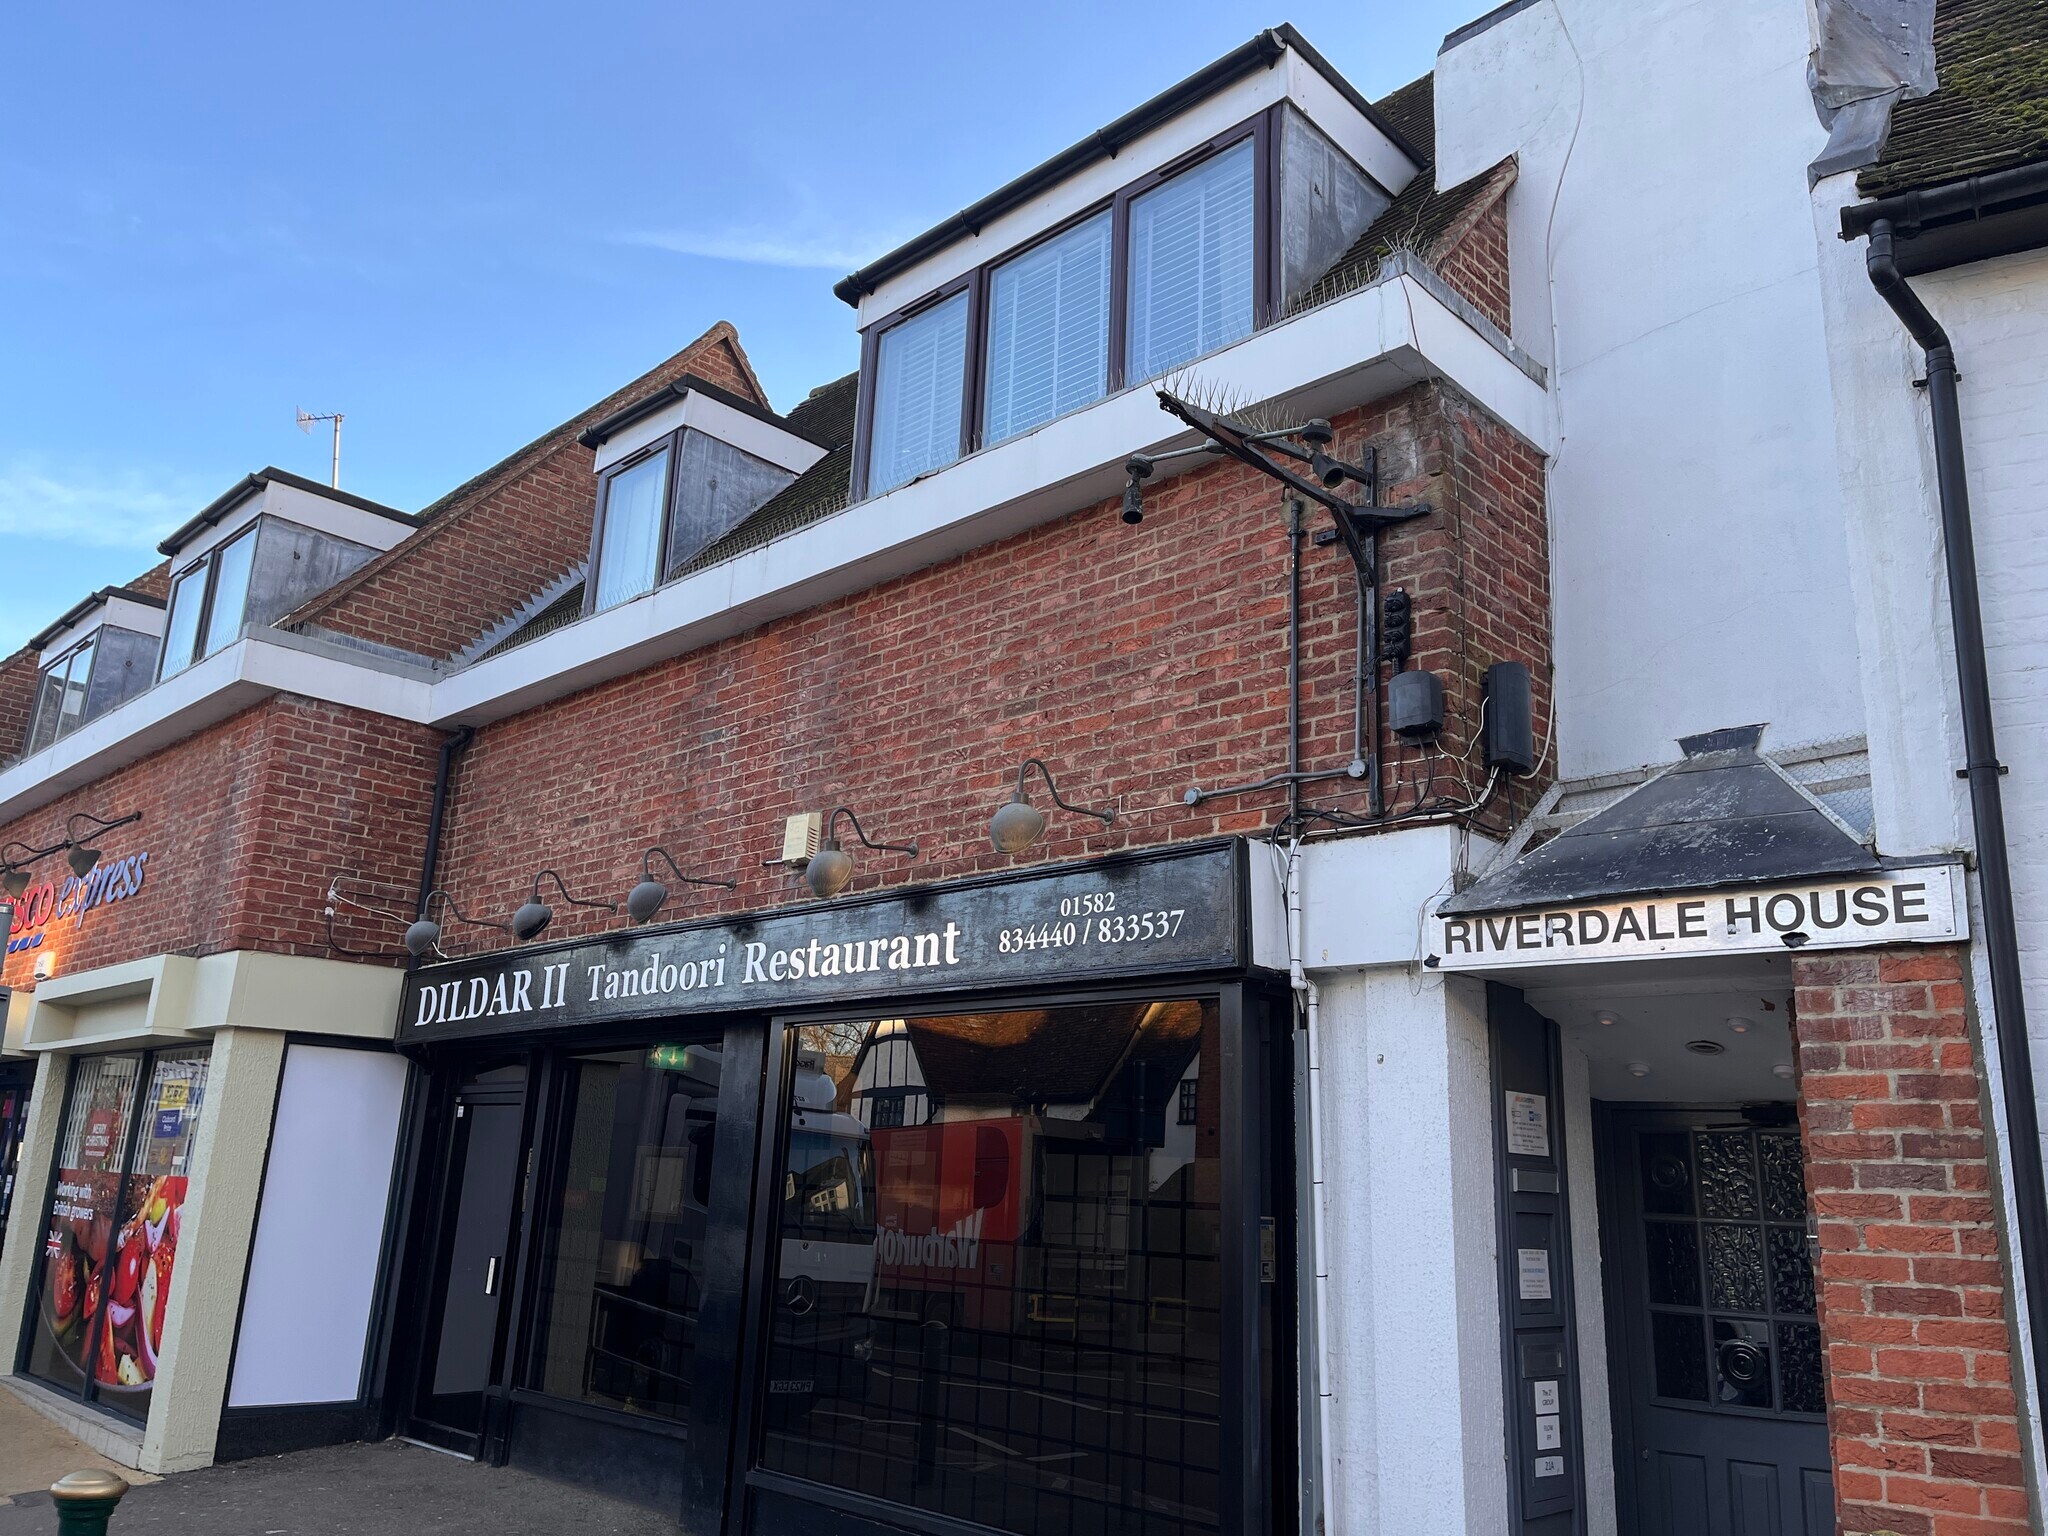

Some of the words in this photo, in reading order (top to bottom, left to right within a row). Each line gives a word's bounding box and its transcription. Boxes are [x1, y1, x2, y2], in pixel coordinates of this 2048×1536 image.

[57, 851, 148, 929] express
[1060, 891, 1116, 917] 01582
[999, 921, 1077, 954] 834440
[1082, 918, 1092, 945] /
[1098, 909, 1186, 943] 833537
[1444, 898, 1709, 955] RIVERDALE
[1725, 882, 1930, 936] HOUSE
[414, 969, 534, 1027] DILDAR
[540, 962, 570, 1010] II
[587, 943, 725, 1002] Tandoori
[741, 921, 961, 984] Restaurant
[85, 1134, 110, 1147] CHRISTMAS
[93, 1123, 107, 1134] MERRY
[57, 1181, 79, 1202] Working
[79, 1183, 92, 1199] with
[53, 1200, 71, 1217] British
[70, 1205, 93, 1221] growers
